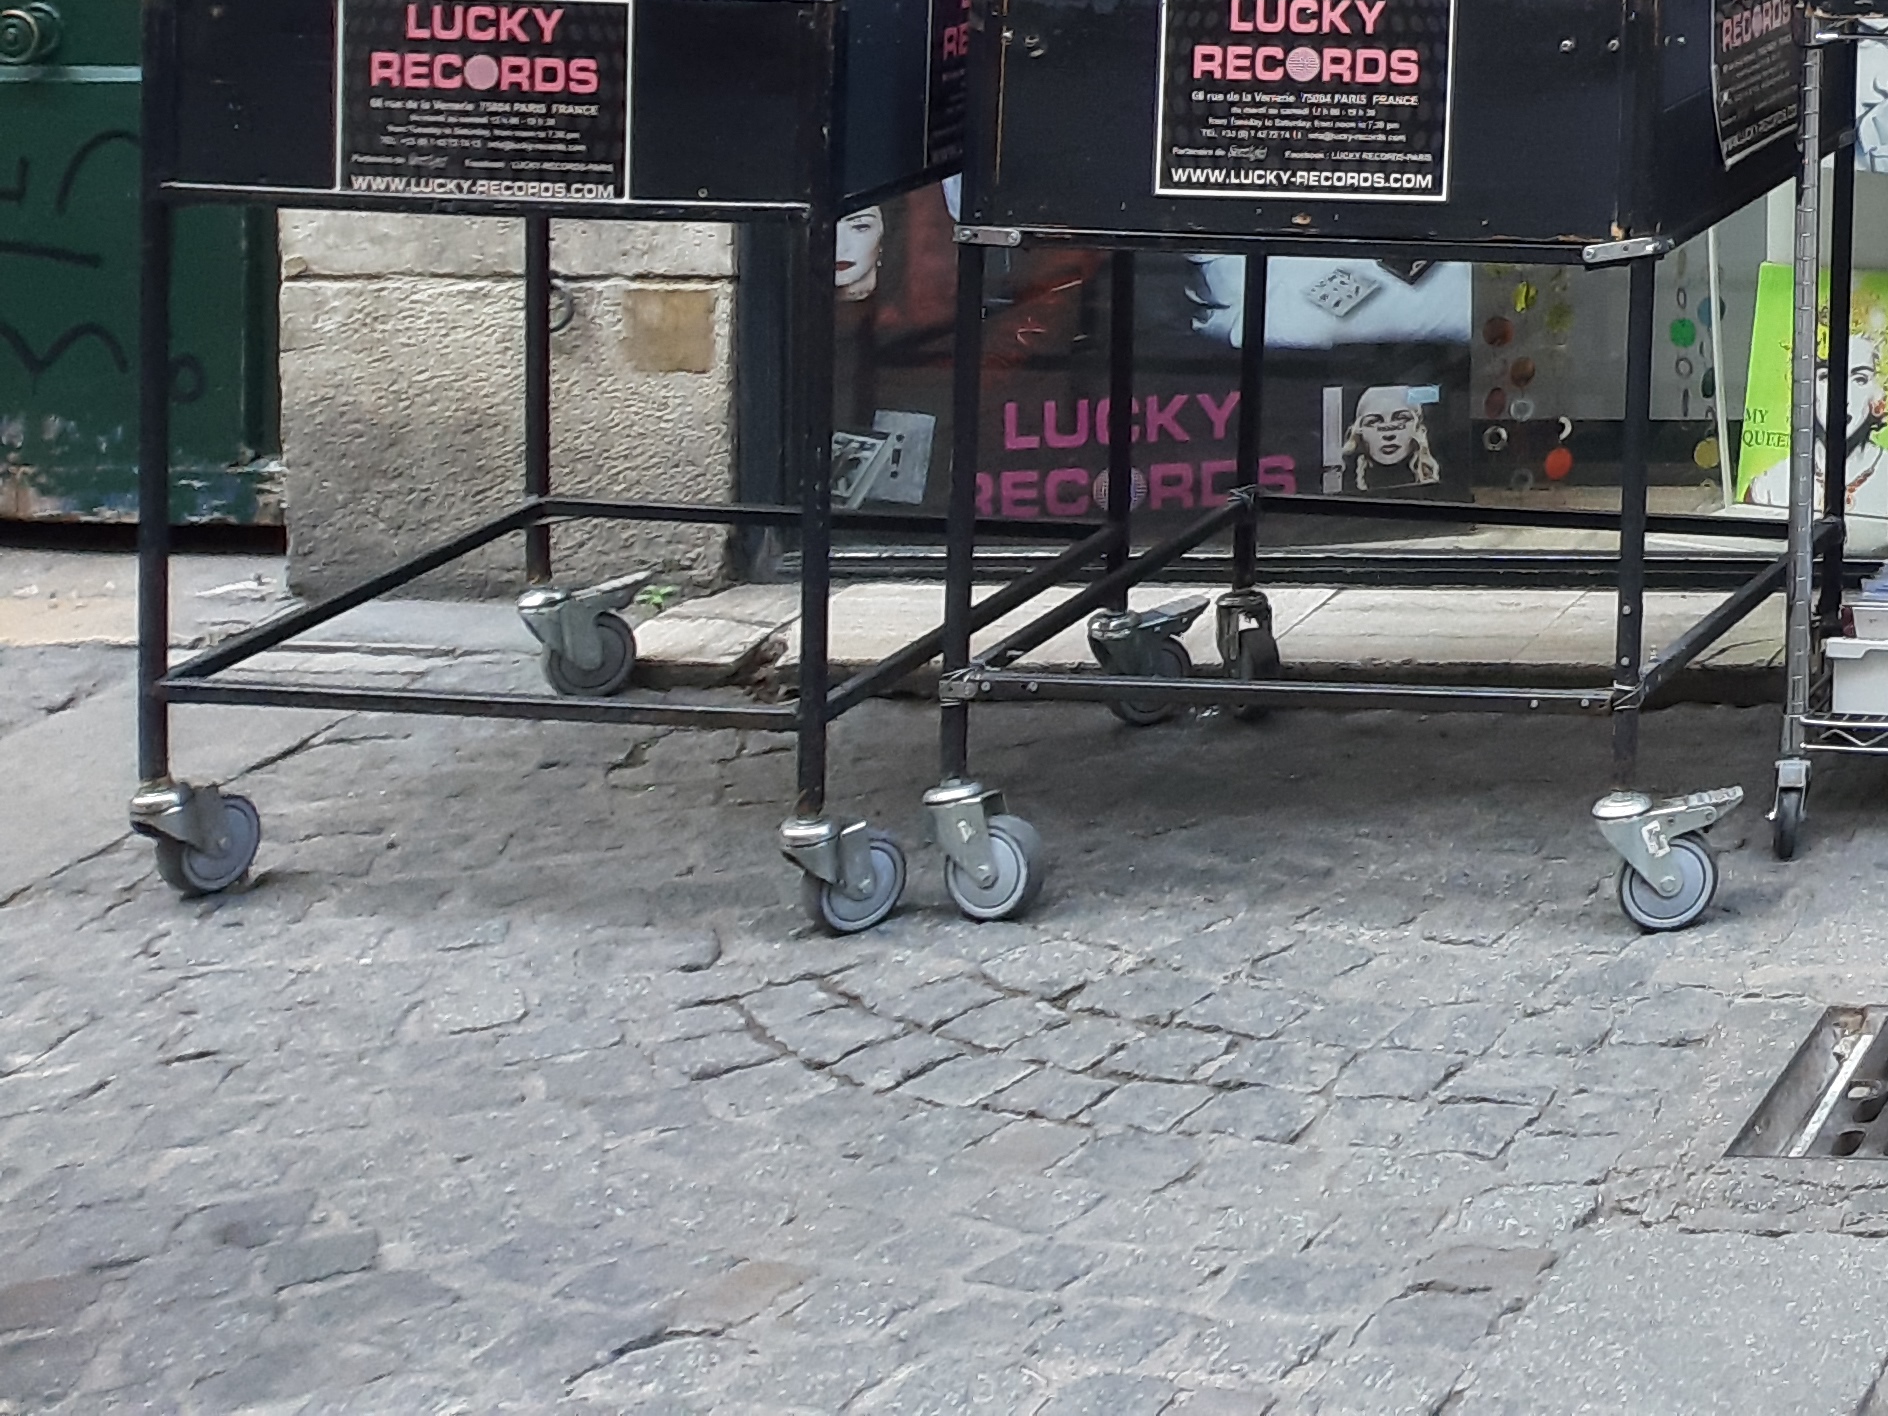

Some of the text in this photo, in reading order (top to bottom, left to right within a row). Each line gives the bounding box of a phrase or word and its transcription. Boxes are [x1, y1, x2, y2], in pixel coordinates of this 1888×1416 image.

[406, 5, 562, 43] LUCKY
[370, 51, 600, 94] RECORDS
[1193, 45, 1420, 86] RECORDS
[351, 175, 614, 199] WWW.LUCKY-RECORDS.COM
[1169, 168, 1432, 190] WWW.LUCKY-RECORDS.COM
